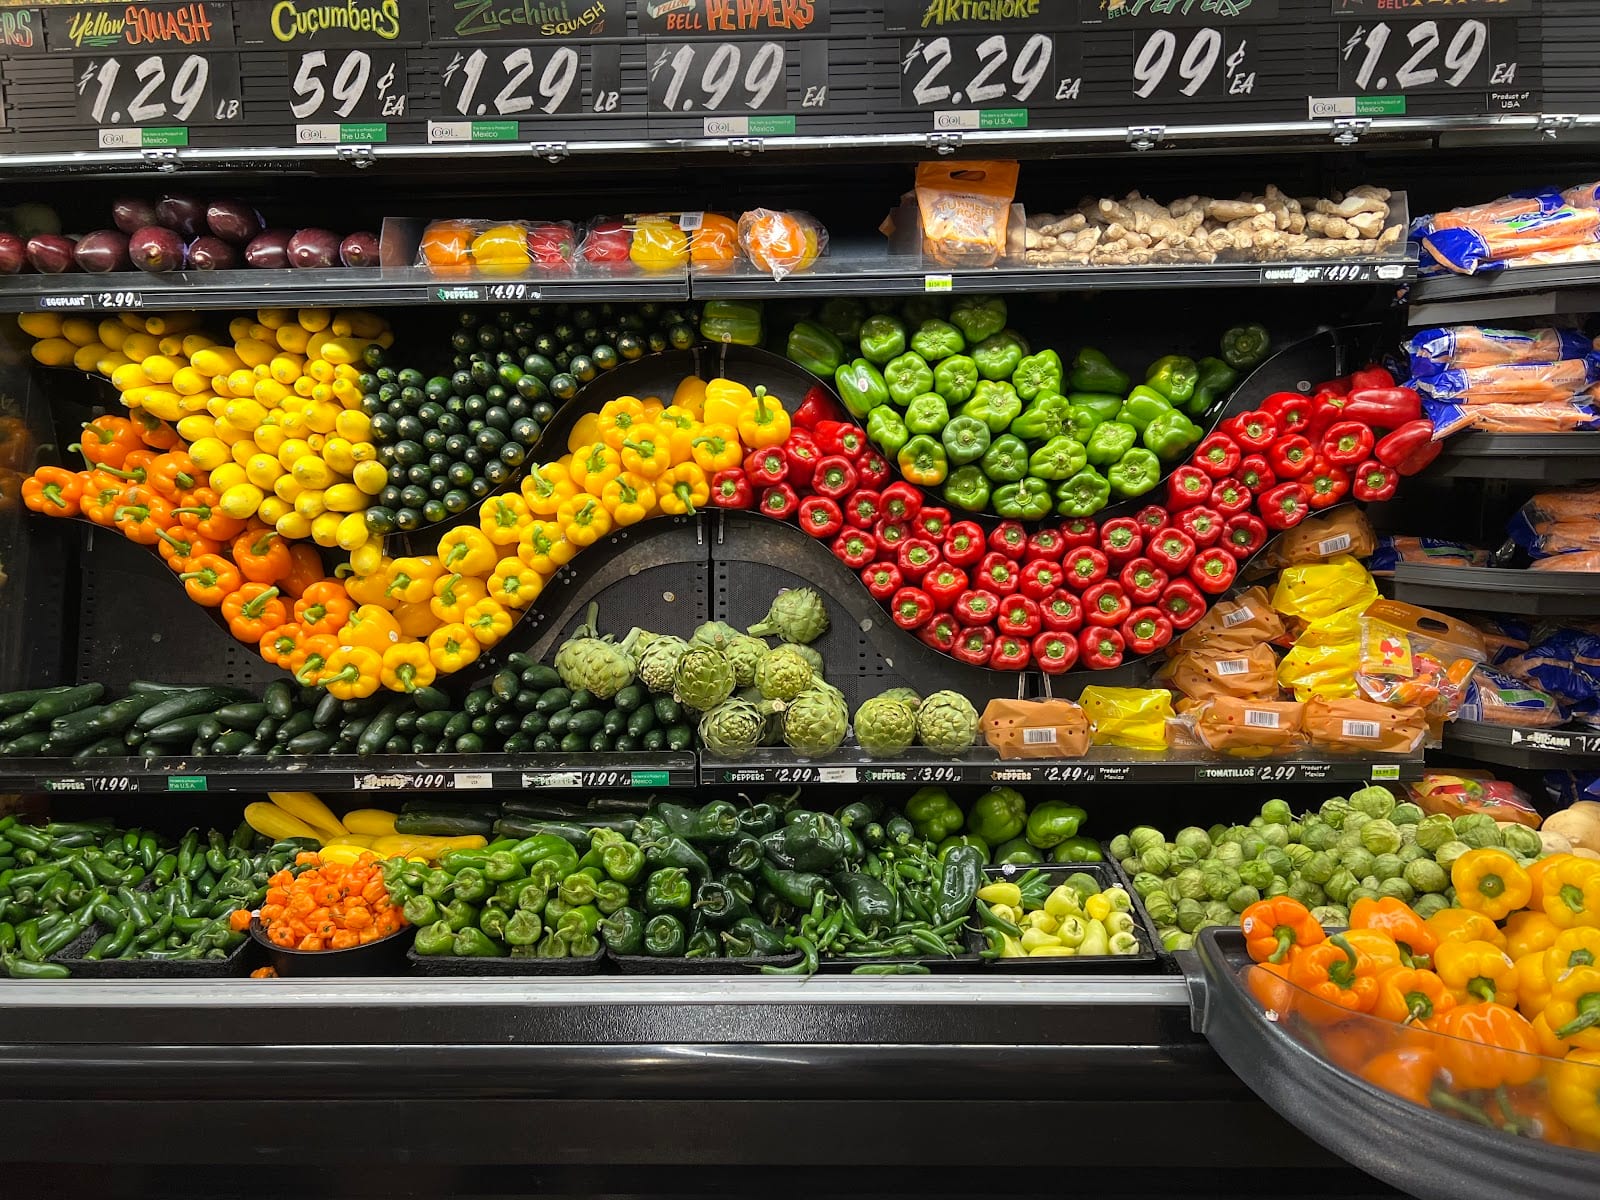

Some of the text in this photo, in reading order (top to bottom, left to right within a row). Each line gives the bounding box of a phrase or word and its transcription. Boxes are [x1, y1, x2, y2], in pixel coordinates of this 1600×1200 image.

[454, 0, 570, 36] Zucchini
[540, 1, 606, 36] SQUASH
[666, 0, 816, 31] BELL PEPPERS
[921, 0, 1040, 28] ARTICHOKE
[1107, 6, 1131, 20] BELL
[68, 3, 212, 47] Yellow SQUASH
[1342, 19, 1517, 91] $1.29 EA
[649, 42, 827, 111] $1.99 EA
[901, 33, 1080, 105] $2.29 EA
[77, 54, 238, 123] $1.29 LB
[441, 47, 619, 116] $1.29 LB
[1229, 72, 1256, 95] EA
[382, 95, 405, 117] EA
[1356, 105, 1384, 113] Mexico
[749, 125, 775, 133] Mexico
[1323, 266, 1360, 280] $4.99
[46, 297, 85, 306] EGGPLANT
[98, 292, 134, 307] $2.99
[445, 290, 479, 299] PEPPERS
[490, 284, 525, 299] $4.99
[583, 772, 617, 786] $1.99
[775, 768, 812, 782] $2.99
[872, 772, 906, 781] PEPPERS
[918, 767, 954, 781] $3.99
[997, 772, 1032, 781] PEPPERS
[1044, 767, 1082, 781] $2.49
[1206, 766, 1296, 781] TOMATILLOS $2.99
[52, 782, 85, 791] PEPPERS
[95, 777, 128, 791] $1.99
